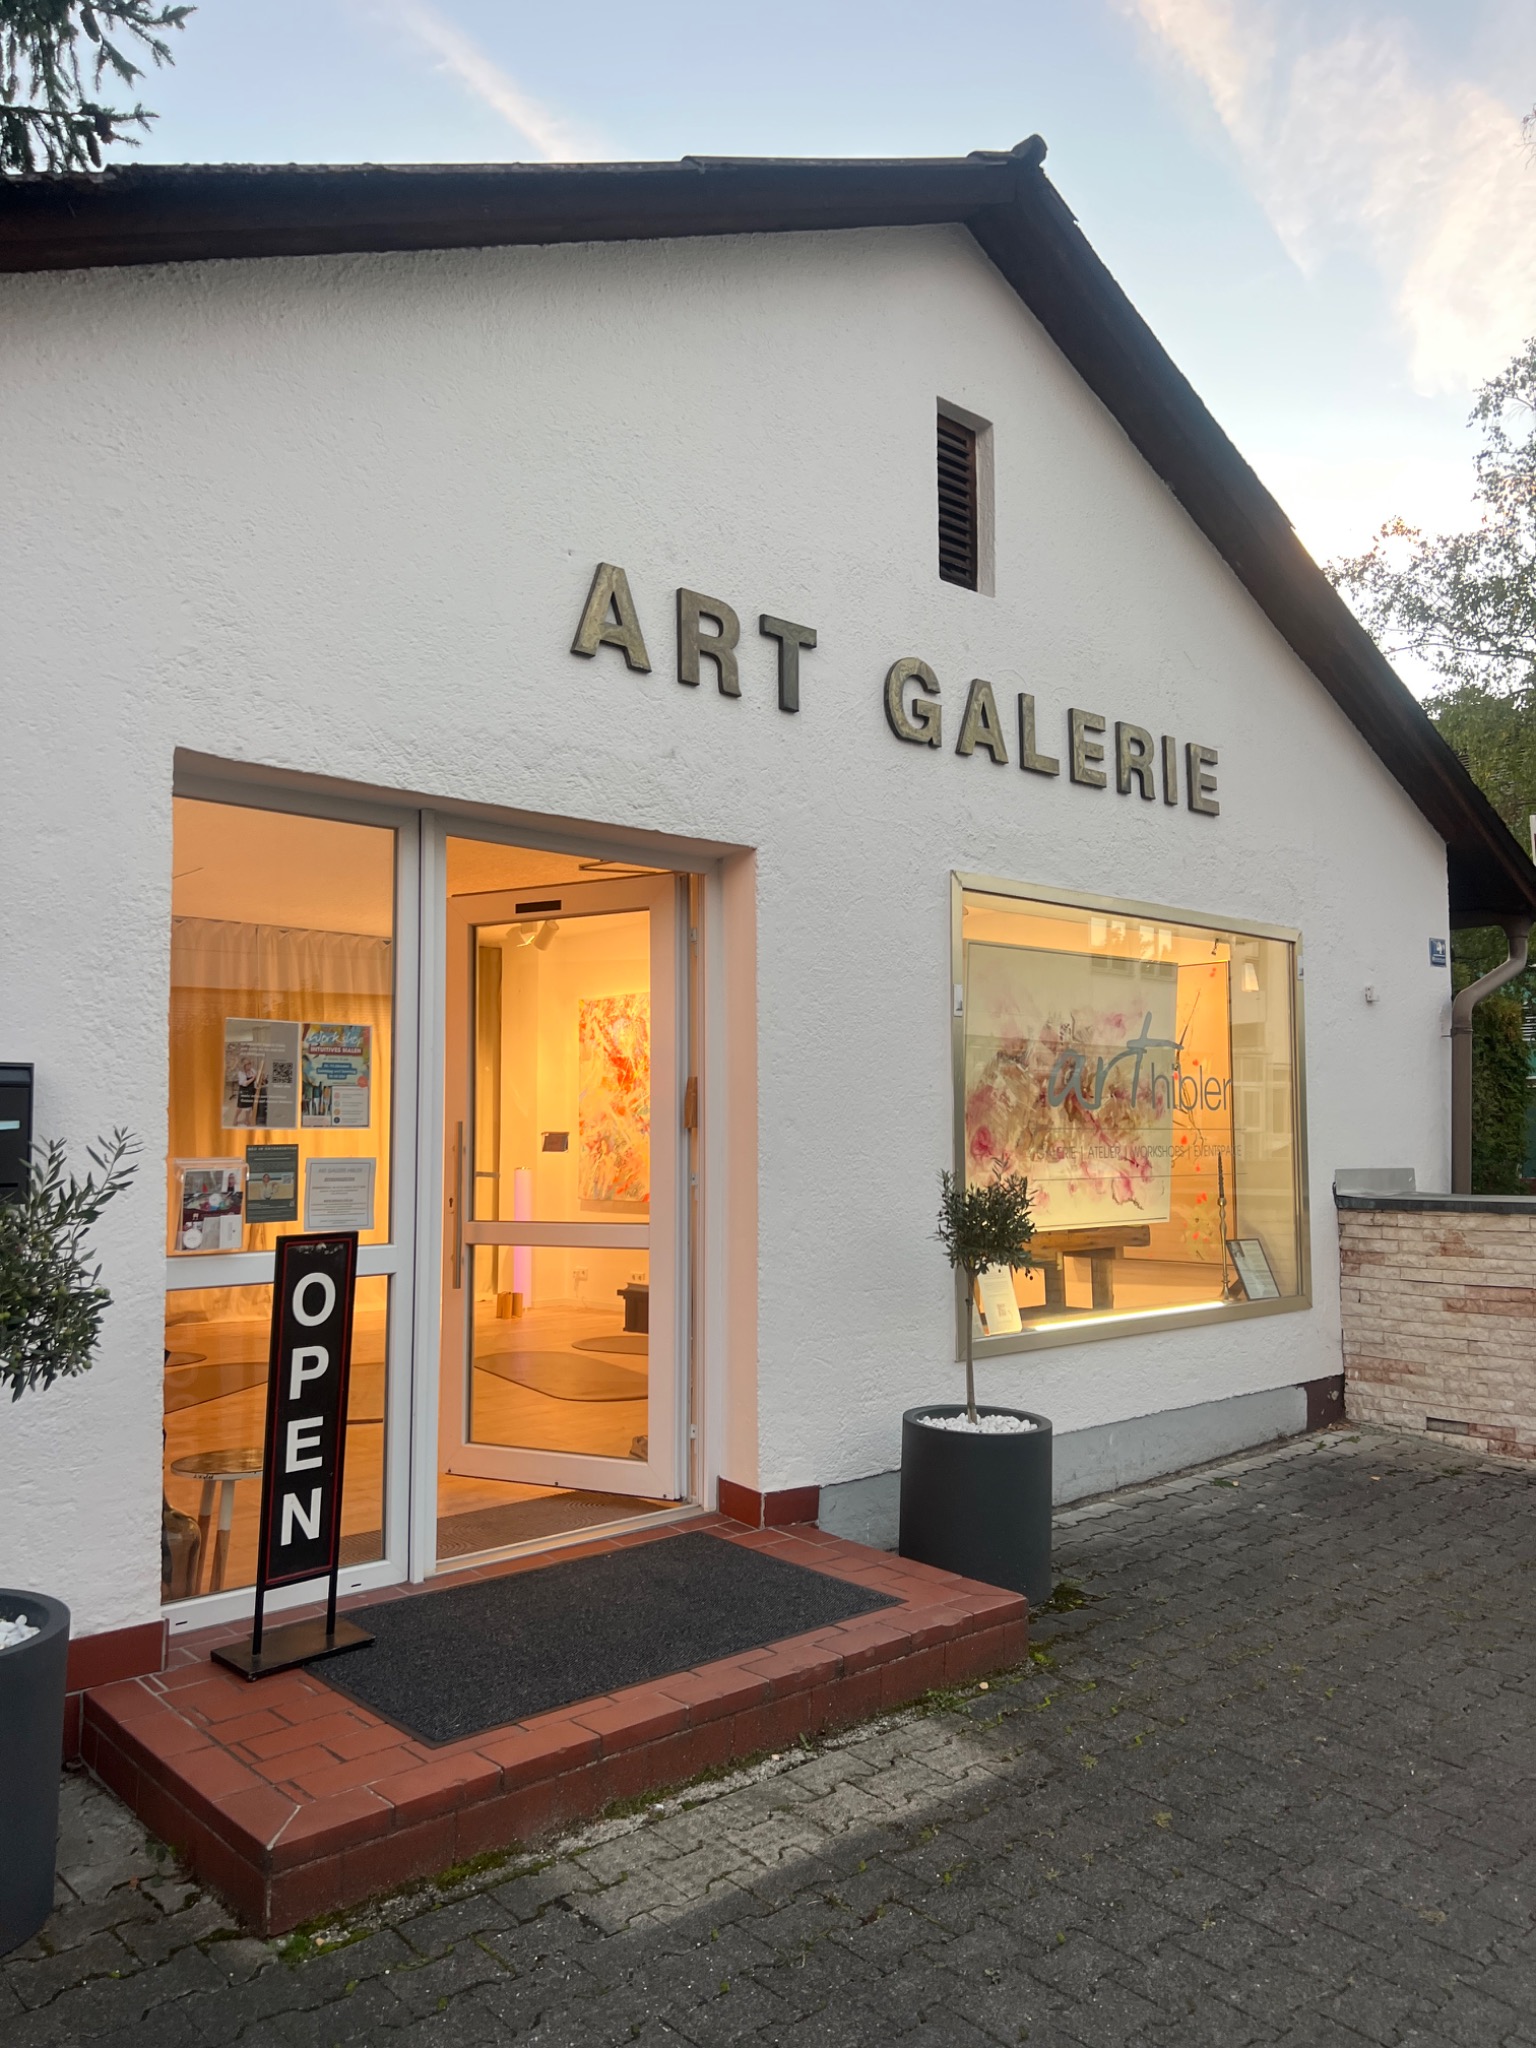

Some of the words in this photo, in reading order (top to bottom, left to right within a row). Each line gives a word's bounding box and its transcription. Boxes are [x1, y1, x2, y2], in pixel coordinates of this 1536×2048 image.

[570, 561, 817, 713] ART
[883, 656, 1220, 816] GALERIE
[1036, 1145, 1077, 1160] GERIE
[1087, 1145, 1120, 1160] ATELIER
[1133, 1144, 1185, 1158] WORKSHOPS
[1193, 1143, 1242, 1158] EVENTSPAE
[280, 1272, 336, 1547] OPEN
